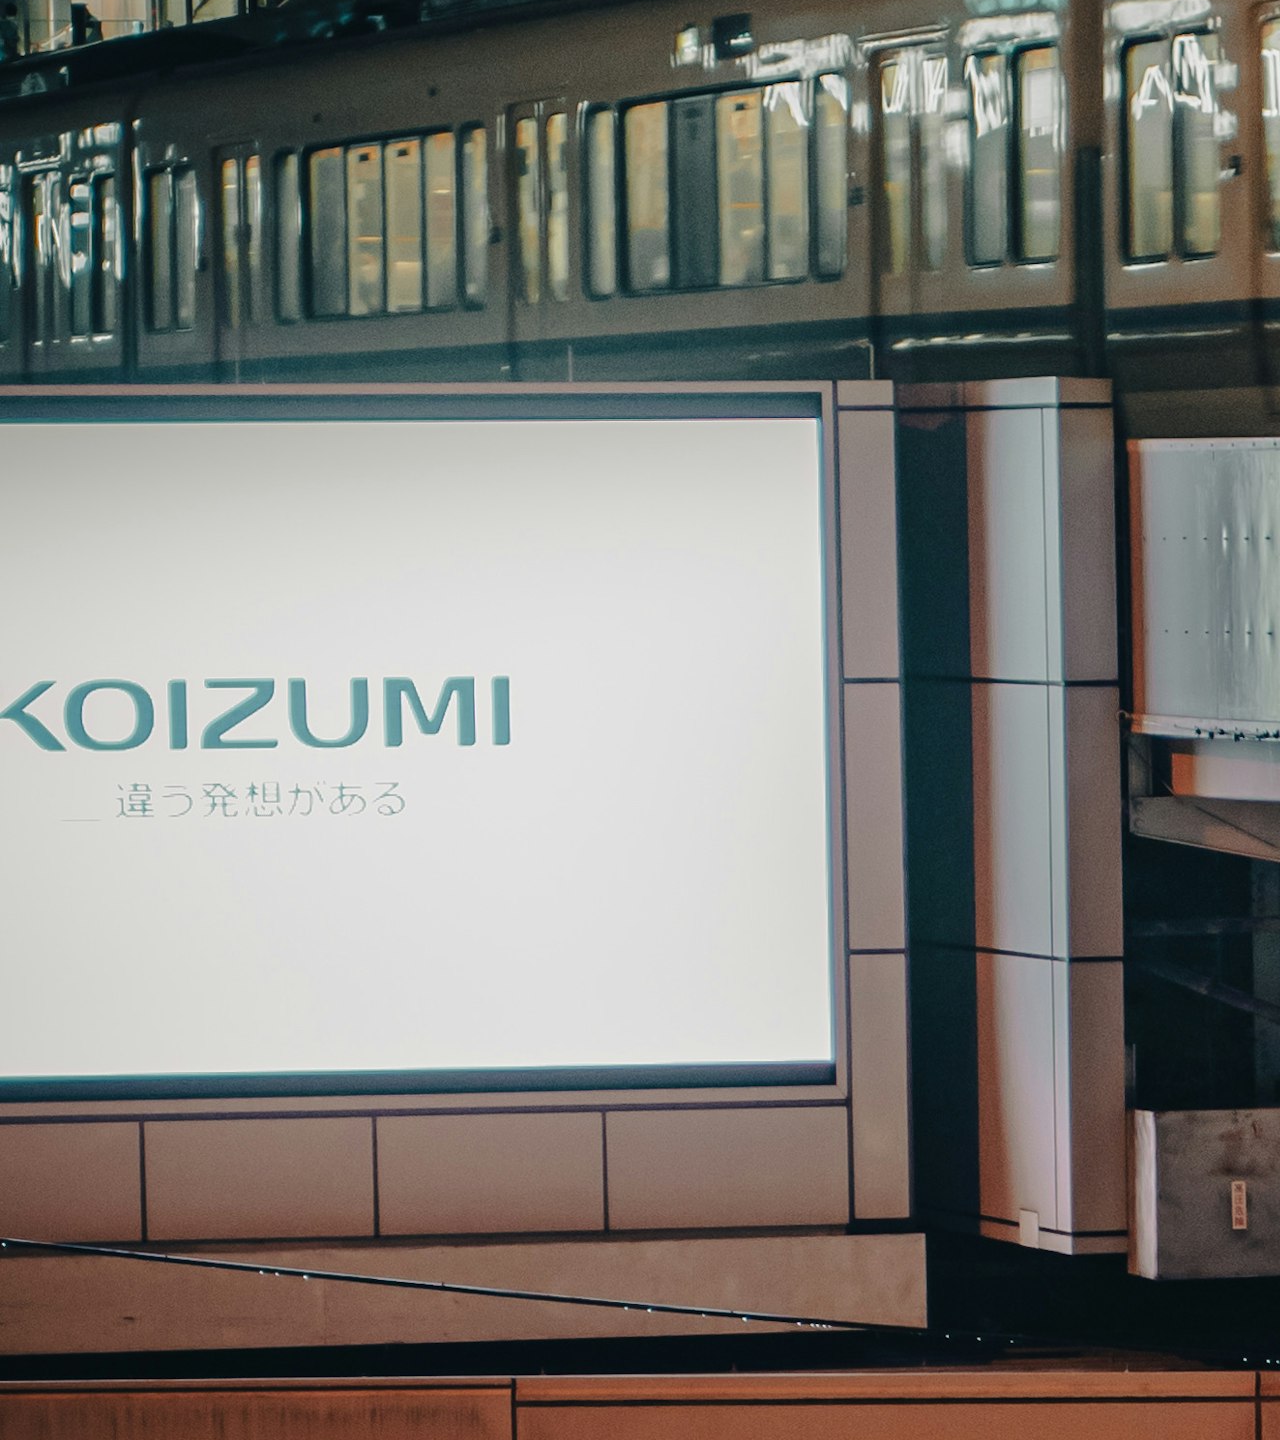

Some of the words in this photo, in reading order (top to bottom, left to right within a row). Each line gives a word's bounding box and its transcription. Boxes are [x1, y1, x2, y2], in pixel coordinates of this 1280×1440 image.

[0, 675, 512, 752] KOIZUMI
[115, 780, 407, 819] 違う発想がある
